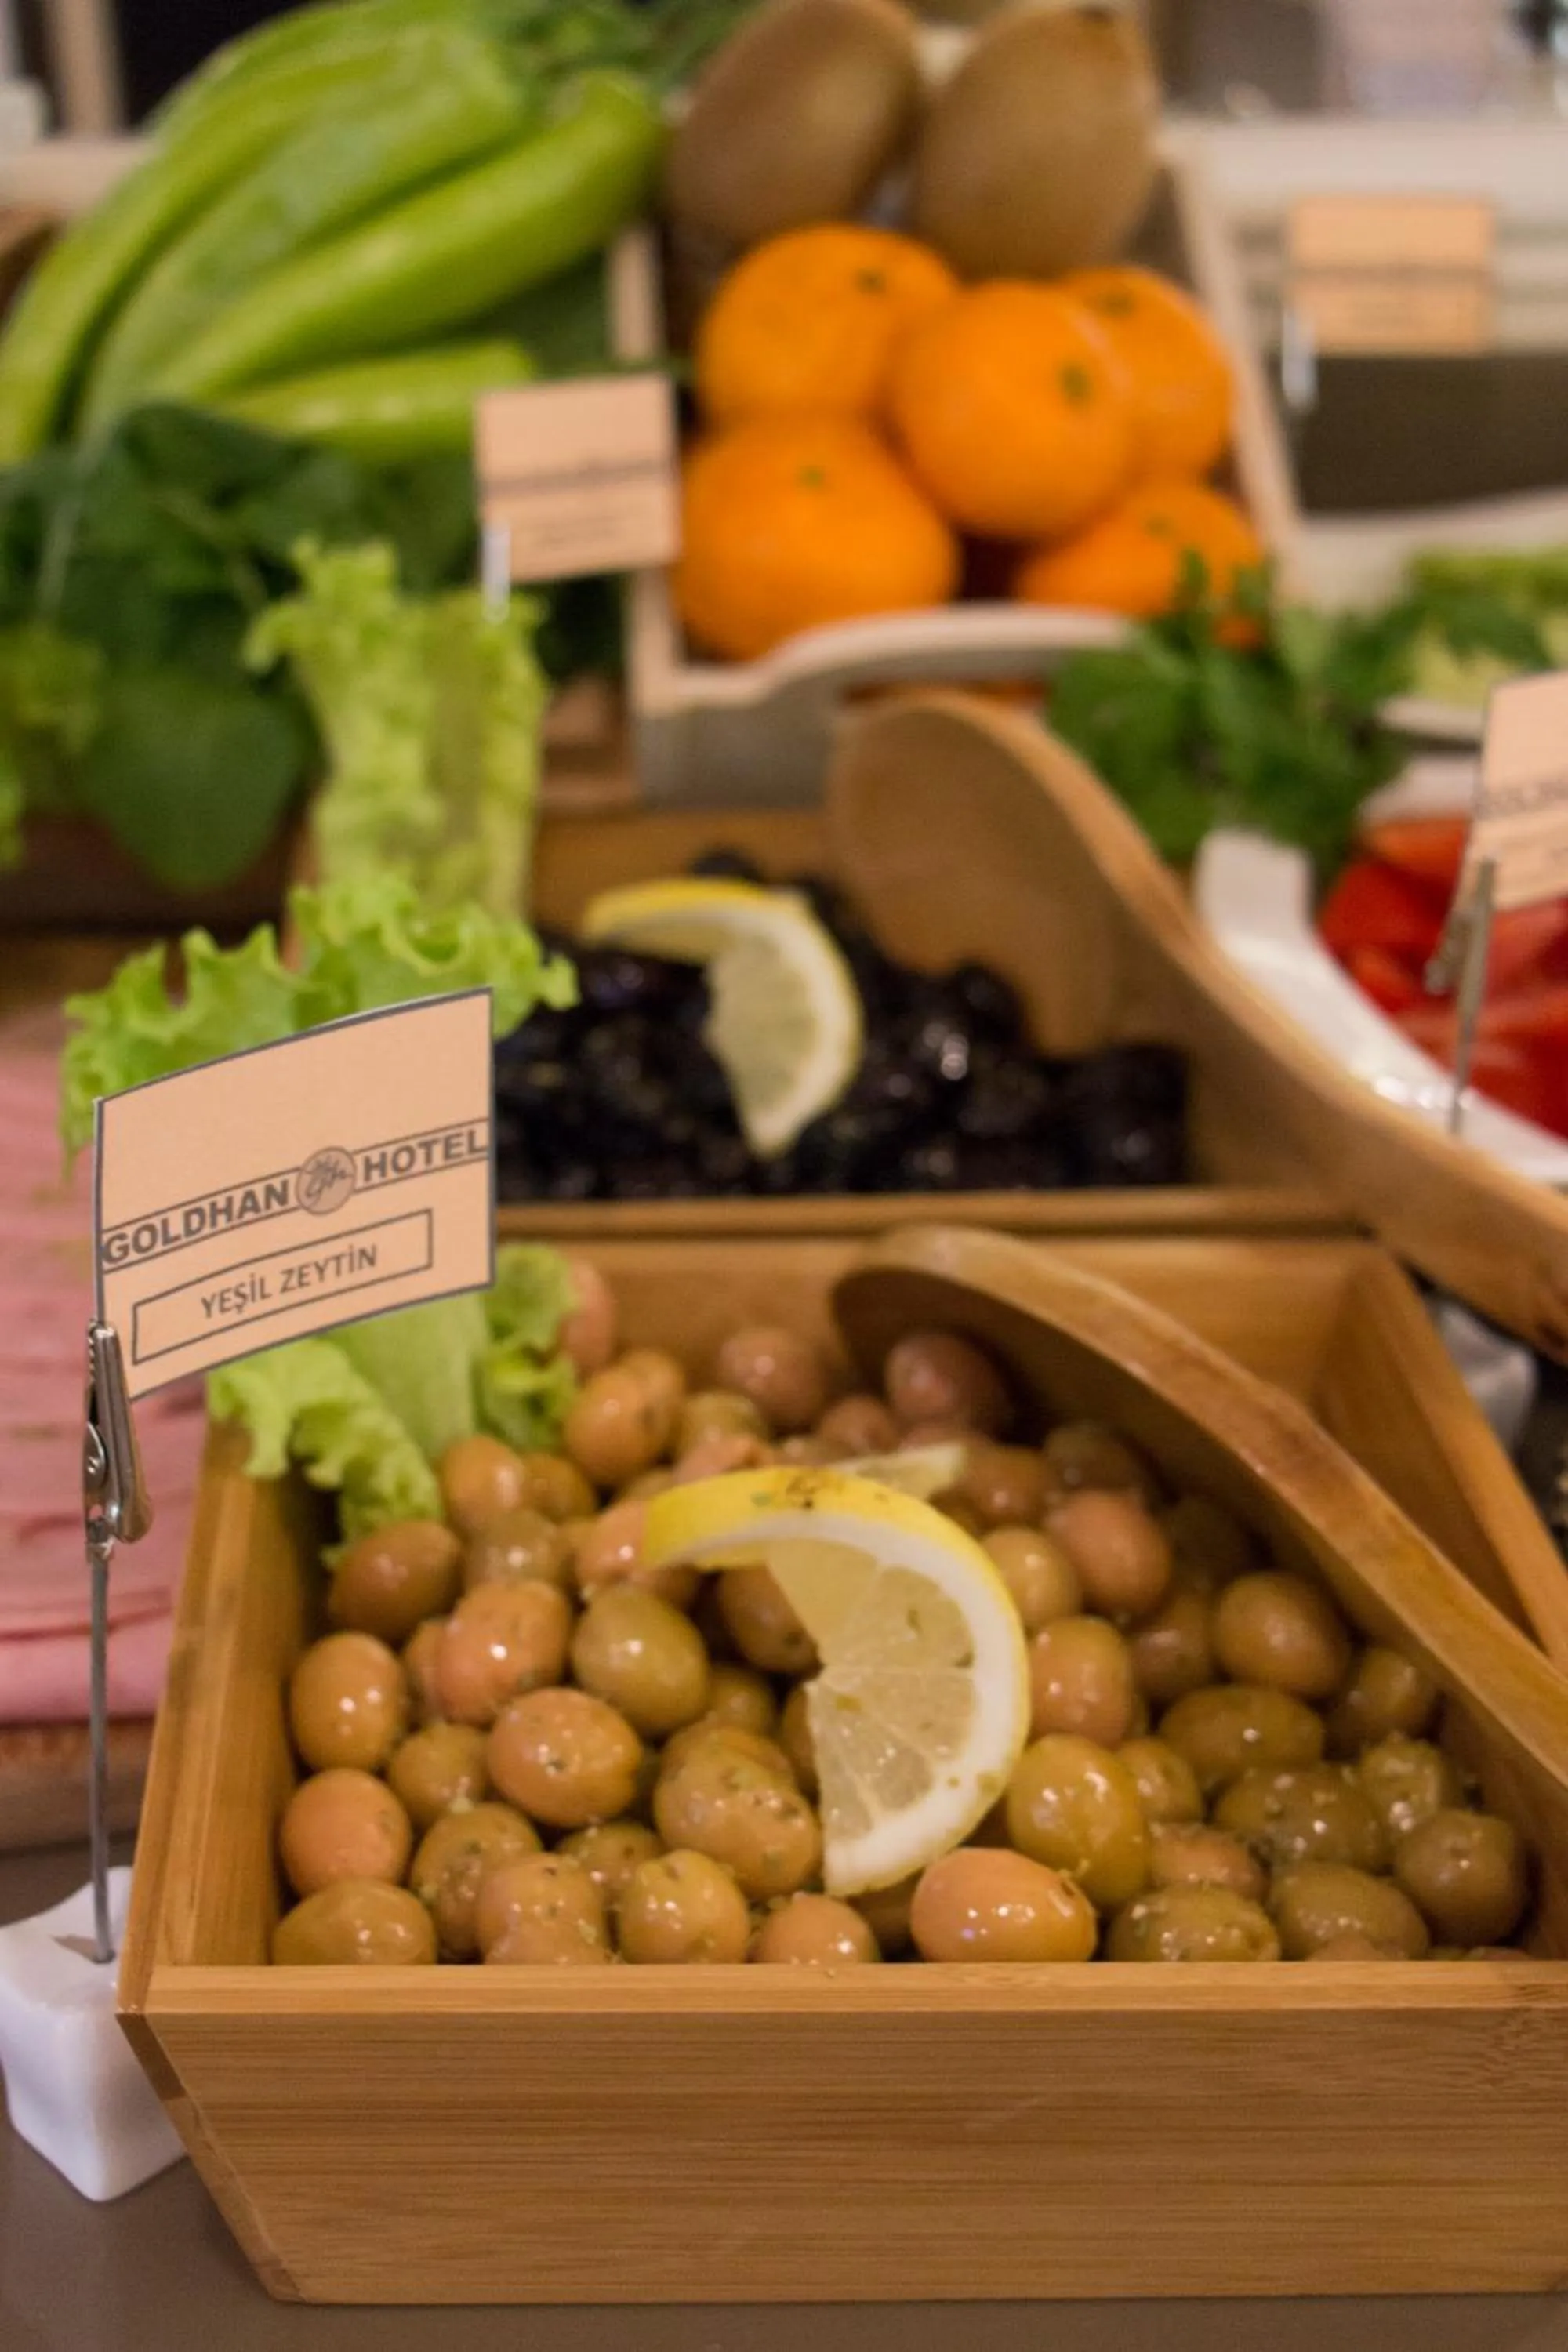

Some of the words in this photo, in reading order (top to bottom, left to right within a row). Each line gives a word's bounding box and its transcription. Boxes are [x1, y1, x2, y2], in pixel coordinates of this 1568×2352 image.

[103, 1178, 289, 1265] GOLDHAN
[363, 1130, 489, 1182] HOTEL
[201, 1272, 272, 1319] YEŞİL
[280, 1243, 378, 1294] ZEYTİN
